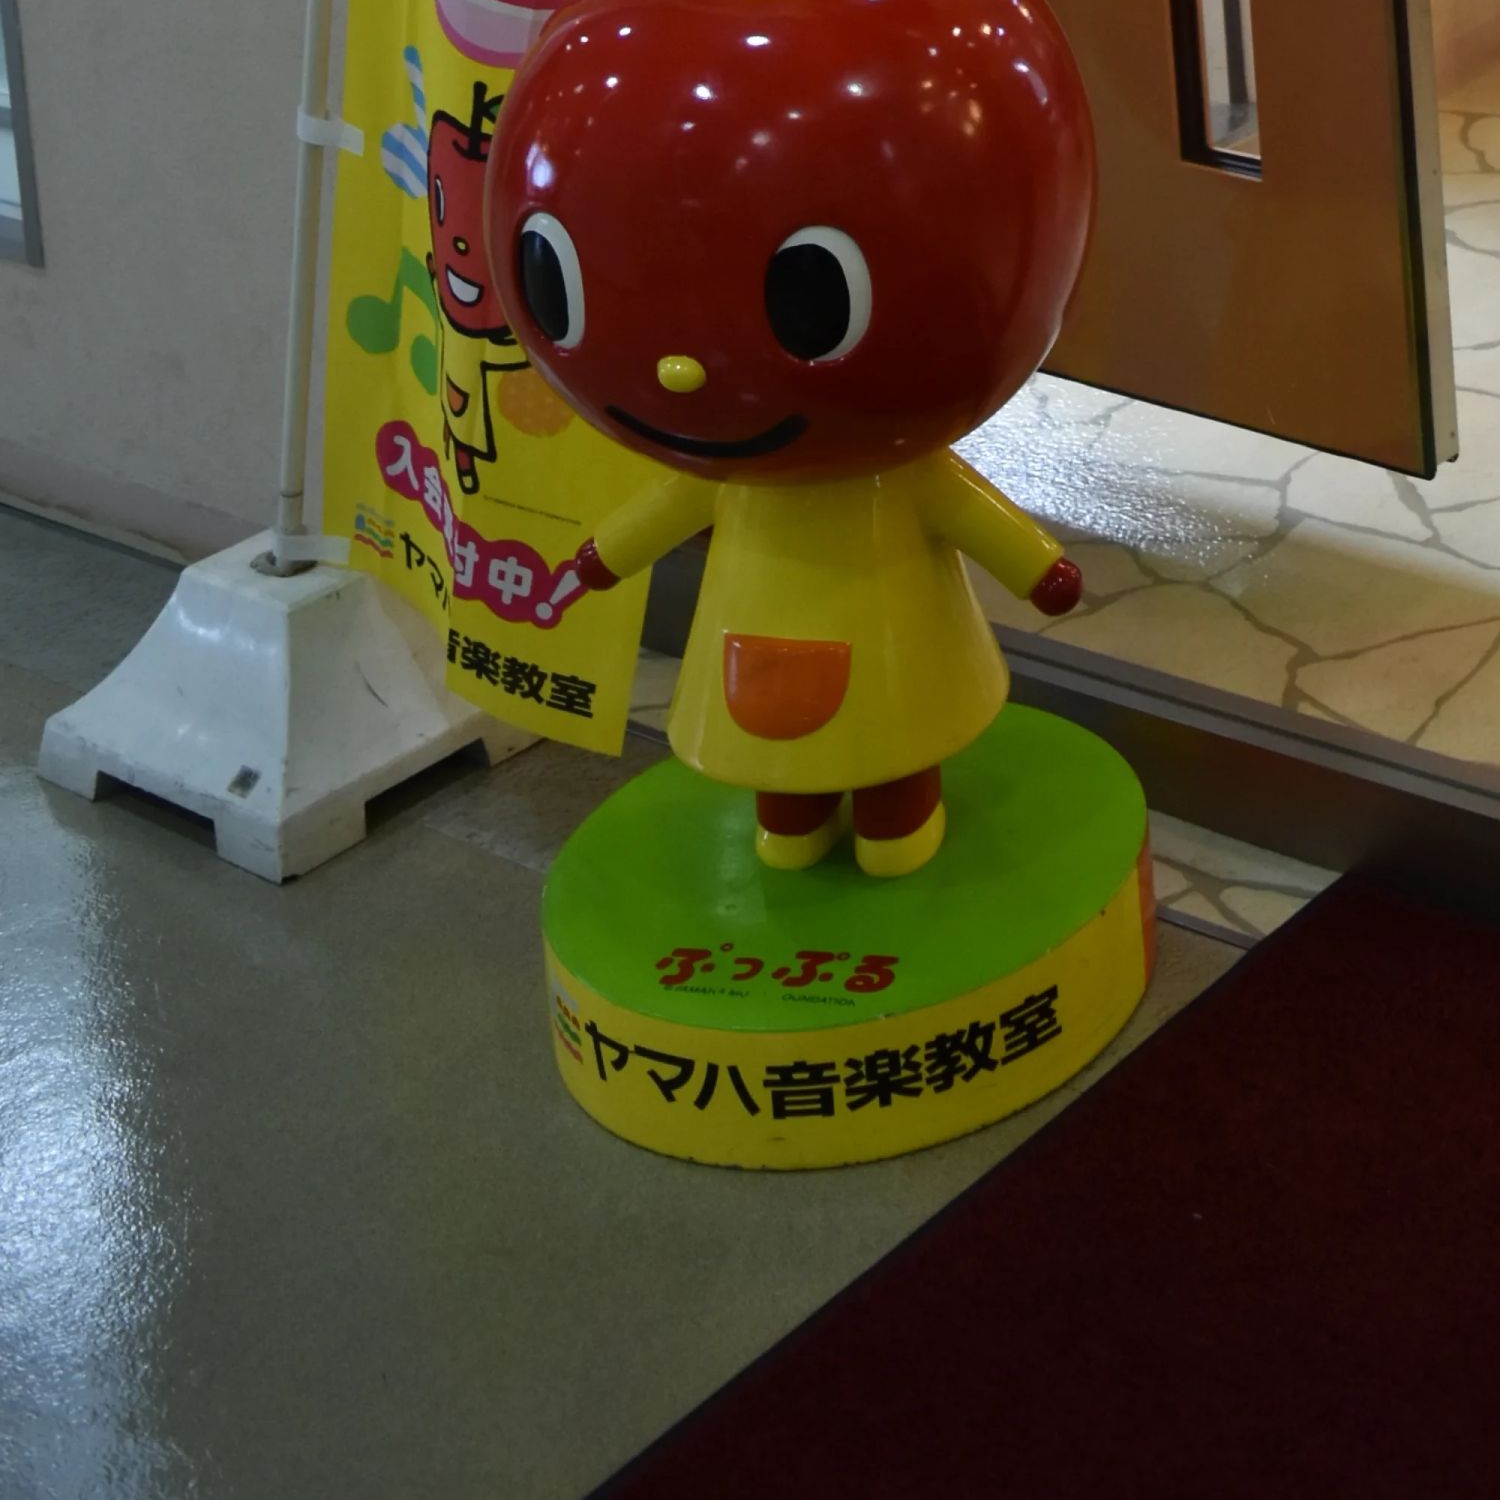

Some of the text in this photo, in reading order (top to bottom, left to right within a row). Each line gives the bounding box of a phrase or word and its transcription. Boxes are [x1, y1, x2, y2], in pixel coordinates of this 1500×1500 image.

[656, 942, 899, 993] ぷっぷる
[584, 985, 1063, 1121] ヤマハ音楽教室
